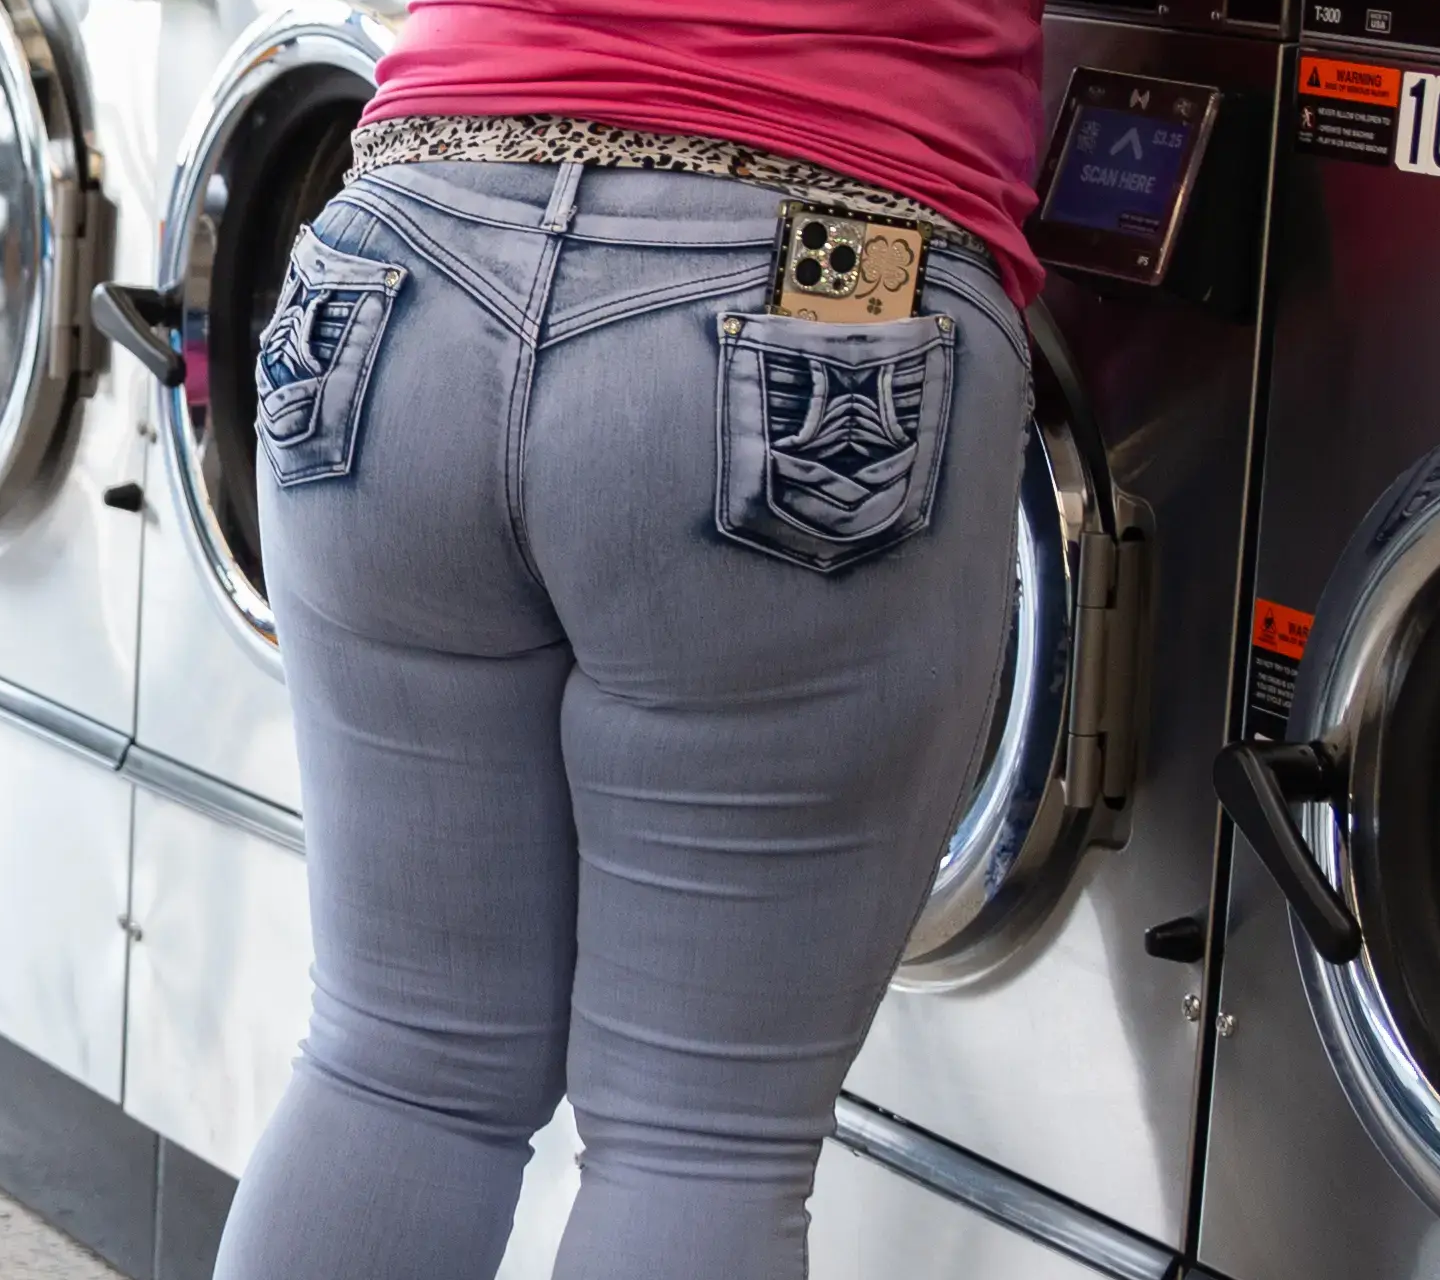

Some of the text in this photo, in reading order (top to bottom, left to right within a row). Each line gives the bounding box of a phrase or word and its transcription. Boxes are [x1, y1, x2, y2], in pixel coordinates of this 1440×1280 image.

[1314, 5, 1342, 24] T-300
[1336, 69, 1382, 87] WARNING
[1080, 164, 1156, 194] SCAN HERE
